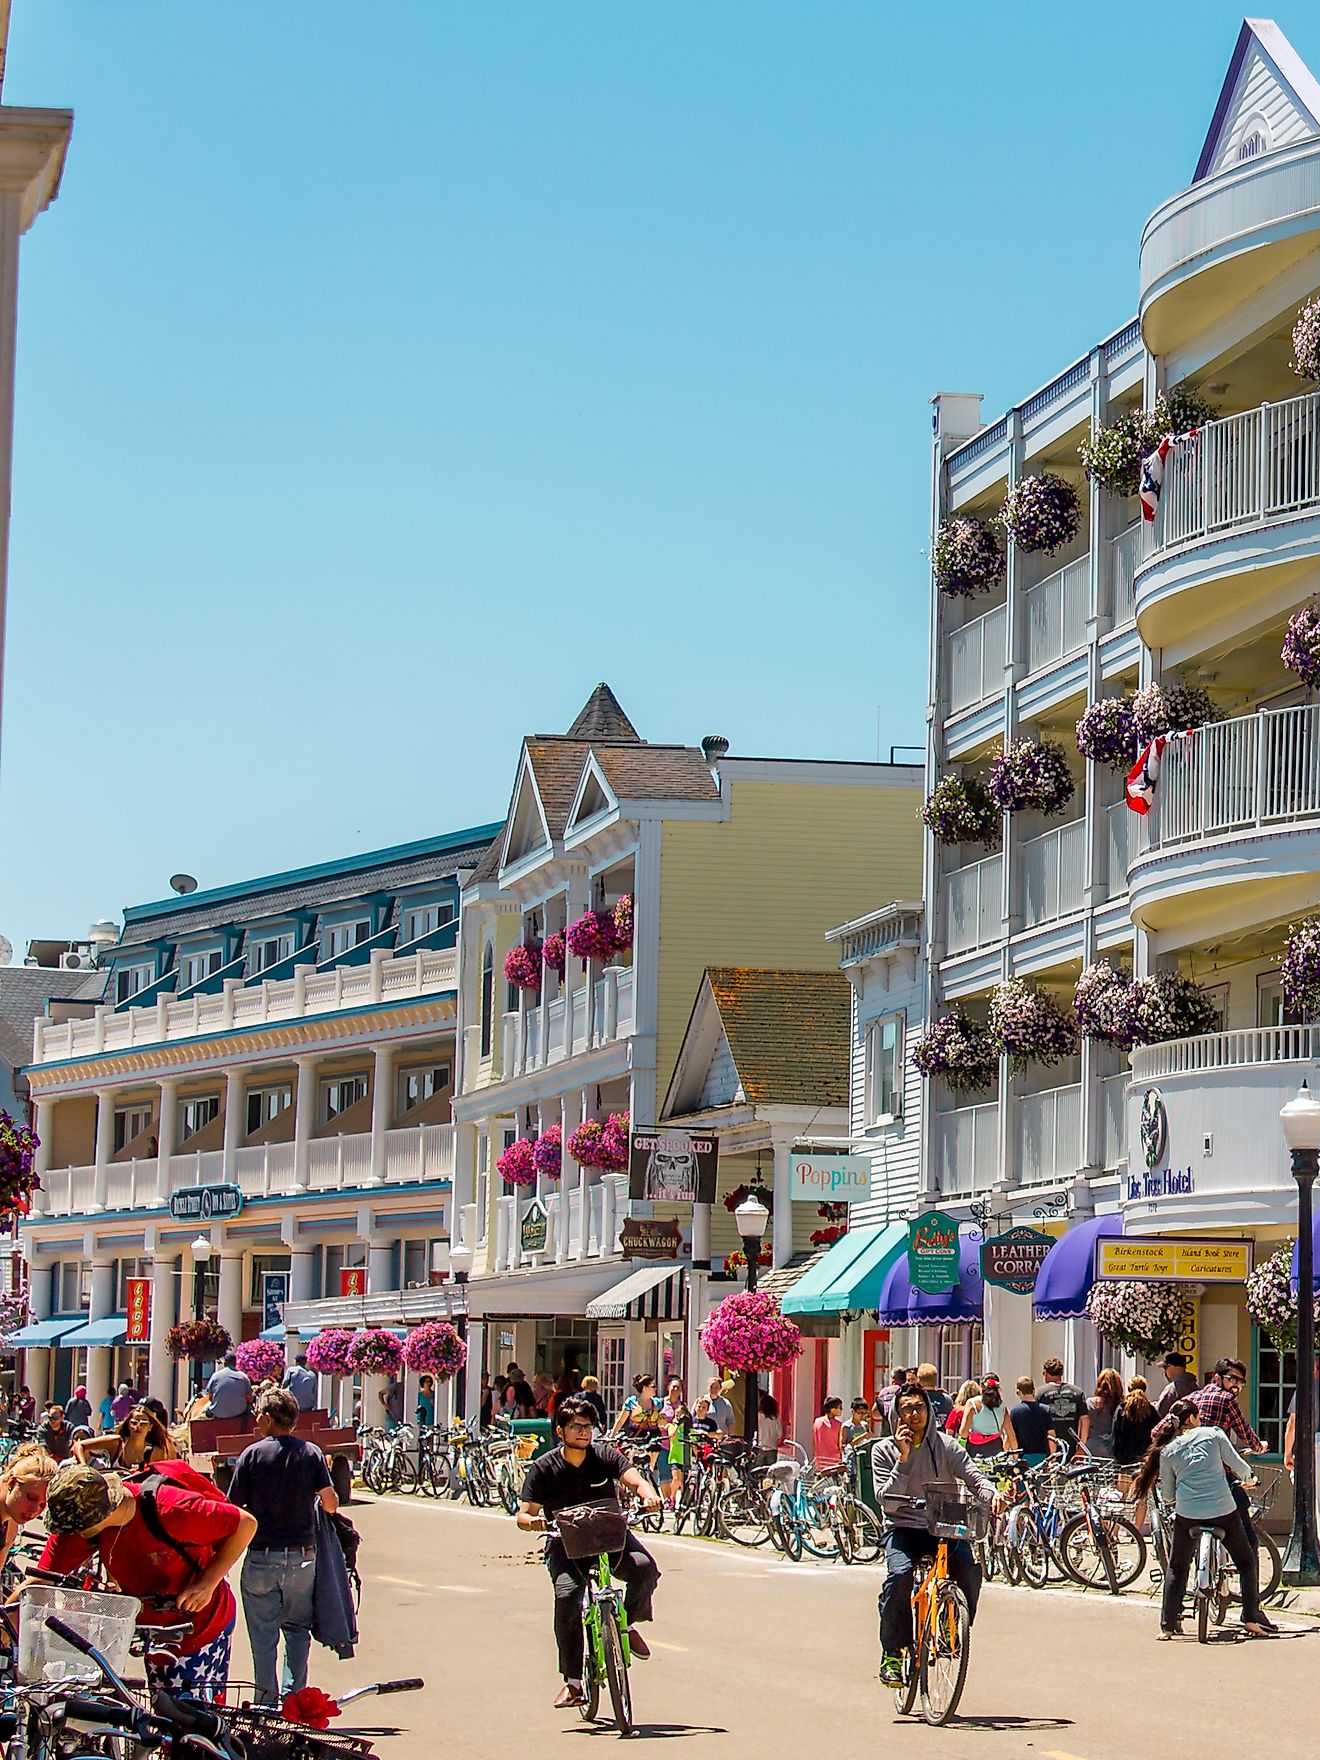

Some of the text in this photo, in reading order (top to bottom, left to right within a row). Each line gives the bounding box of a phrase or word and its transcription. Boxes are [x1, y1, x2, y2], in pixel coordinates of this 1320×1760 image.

[634, 1138, 712, 1153] GET SPOOKED
[796, 1163, 868, 1191] Poppins
[1163, 1166, 1192, 1195] Hotel
[676, 1189, 696, 1201] fun
[991, 1244, 1051, 1259] LEATHER
[1114, 1247, 1164, 1257] Birkenstock
[1181, 1248, 1240, 1258] Island Book Store
[1108, 1263, 1168, 1275] Great Turtle Toys
[1190, 1264, 1233, 1274] Caricatures
[131, 1283, 143, 1336] LEGO
